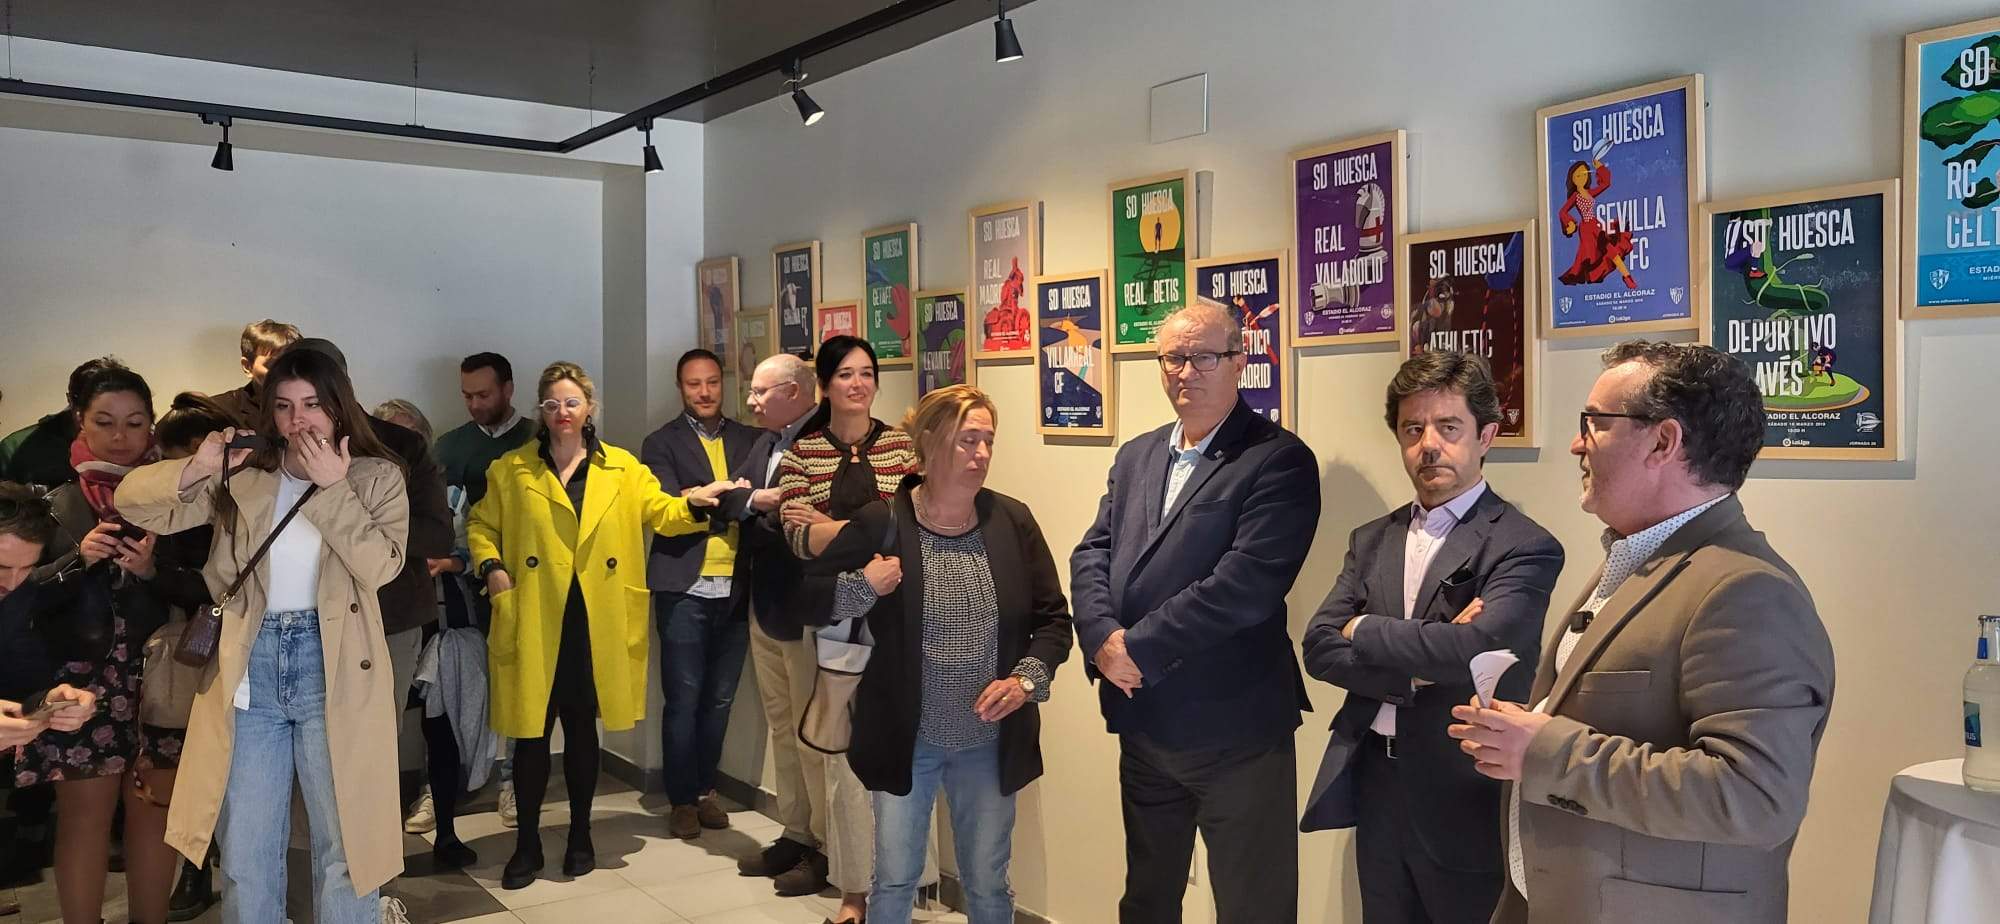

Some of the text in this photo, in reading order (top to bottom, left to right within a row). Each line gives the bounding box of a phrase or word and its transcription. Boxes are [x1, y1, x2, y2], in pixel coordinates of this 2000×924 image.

[1960, 46, 1990, 88] SD
[1572, 103, 1665, 152] SD HUESCA
[1313, 152, 1378, 190] SD HUESCA
[1947, 158, 1977, 201] RC
[1126, 187, 1173, 219] SD HUESCA
[1596, 195, 1667, 235] SEVILLA
[983, 216, 1020, 242] SD HUESCA
[1315, 224, 1346, 254] REAL
[1778, 208, 1855, 251] HUESCA
[1946, 206, 2000, 249] CELT
[883, 238, 903, 259] HUESCA
[1429, 242, 1505, 279] SD HUESCA
[1630, 237, 1650, 271] FC
[983, 258, 1002, 280] REAL
[1212, 268, 1268, 298] SD HUESCA
[1316, 256, 1384, 287] VALLADOLID
[1969, 266, 2000, 274] ESTAD
[1048, 284, 1092, 311] SD HUESCA
[1124, 278, 1180, 307] REAL BETIS
[1584, 288, 1656, 301] ESTADIO EL ALCORAZ
[924, 300, 958, 323] SD HUESCA
[1241, 327, 1270, 356] ÉTICO
[1728, 313, 1837, 354] DEPORTIVO
[924, 350, 951, 371] LEVANTE
[1756, 354, 1803, 396] AVÉS
[1054, 371, 1065, 394] CF
[1238, 363, 1272, 389] ADRID
[1801, 412, 1841, 420] ALCORAZ
